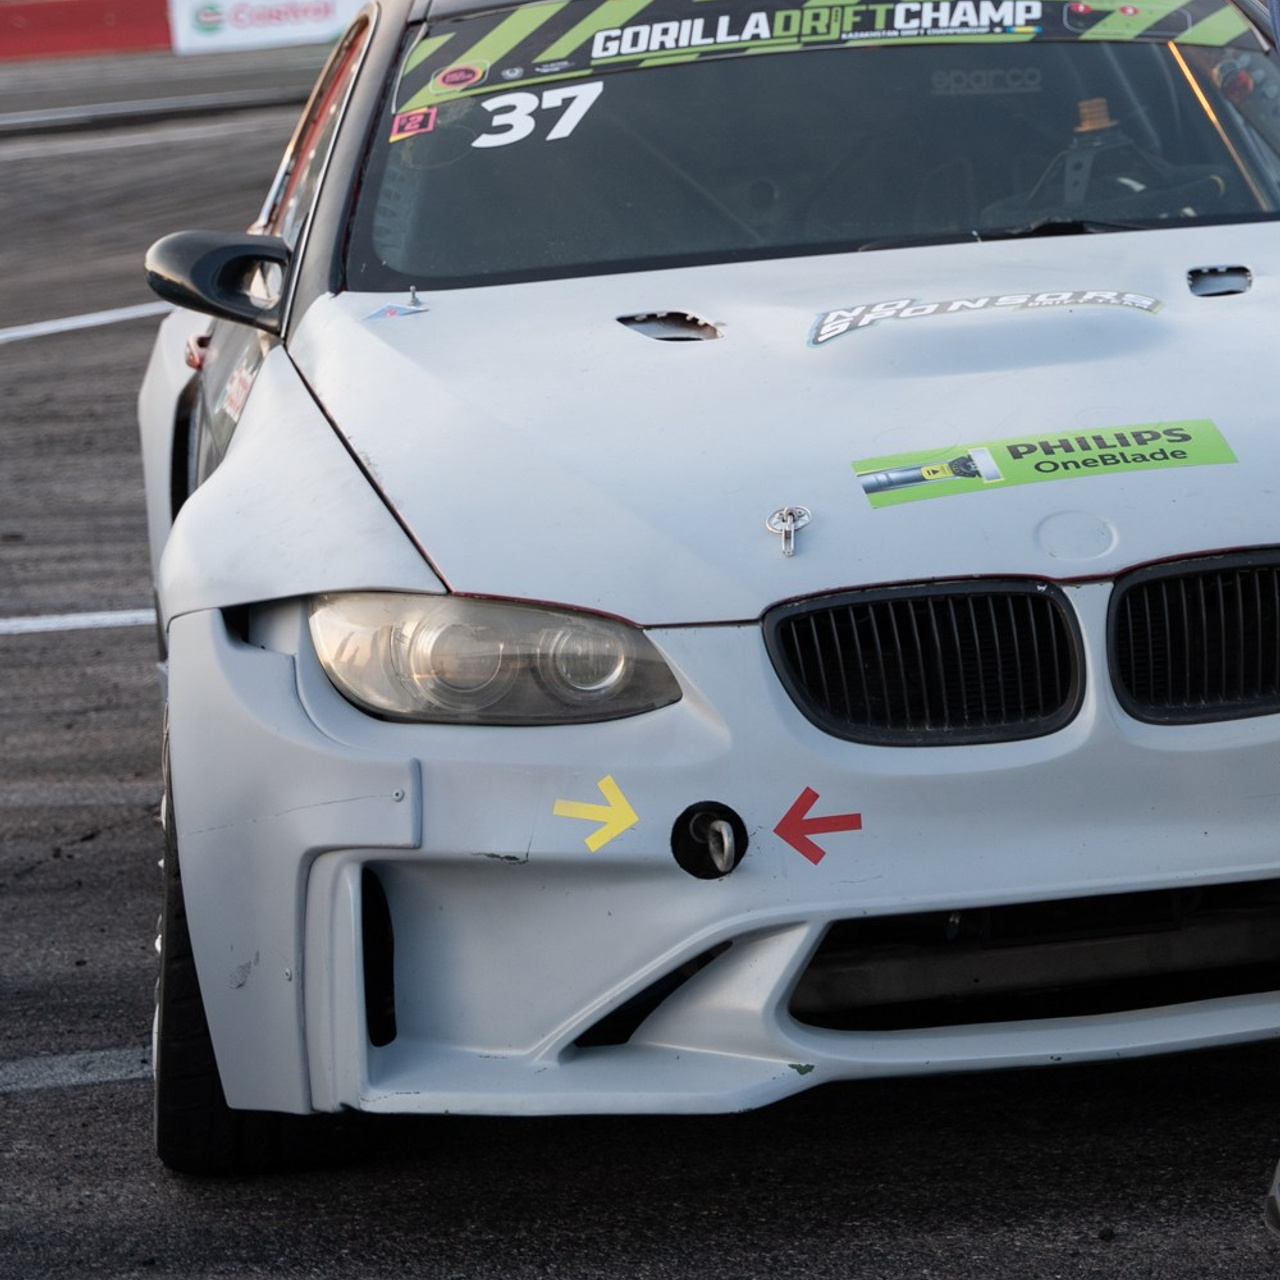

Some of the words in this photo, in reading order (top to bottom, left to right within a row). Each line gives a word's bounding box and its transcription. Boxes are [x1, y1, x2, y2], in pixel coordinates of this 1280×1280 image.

[470, 81, 604, 148] 37
[816, 290, 1158, 343] SPONSORS
[822, 299, 913, 324] NO
[1006, 427, 1192, 460] PHILIPS
[1034, 448, 1187, 474] OneBlade
